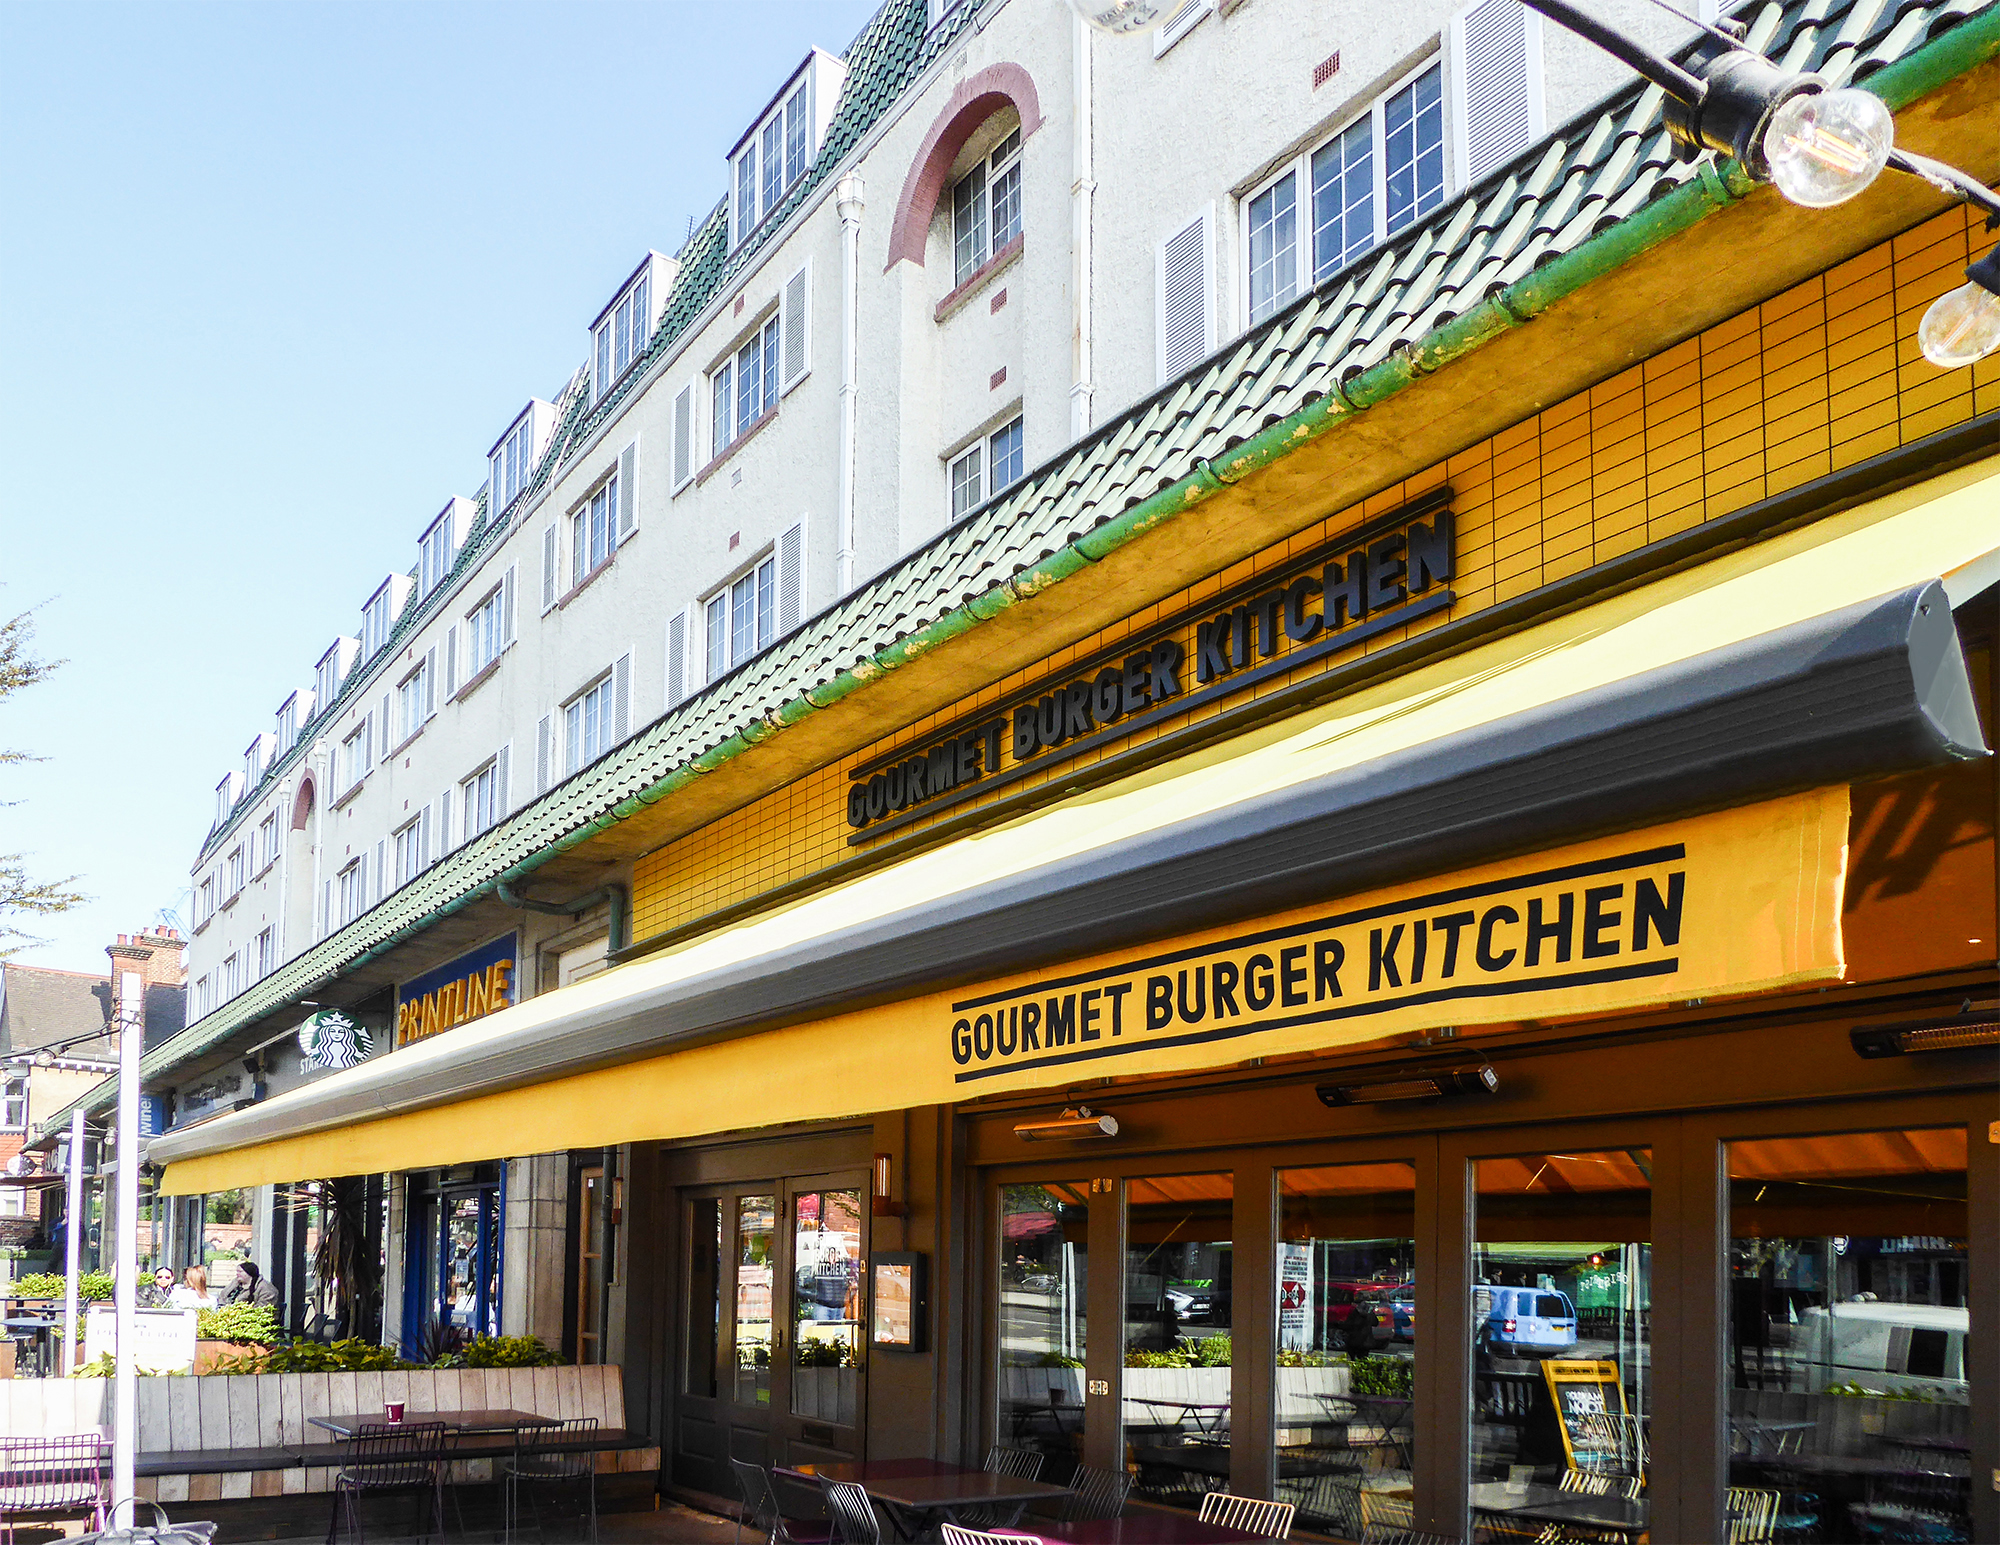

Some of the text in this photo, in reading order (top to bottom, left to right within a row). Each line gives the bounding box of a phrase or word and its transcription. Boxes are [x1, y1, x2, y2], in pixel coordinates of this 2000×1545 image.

[847, 509, 1455, 828] GOURMET BURGER KITCHEN
[397, 958, 513, 1046] PRINTLINE
[951, 871, 1686, 1065] GOURMET BURGER KITCHEN
[300, 1056, 321, 1075] STAR
[814, 1261, 846, 1276] KITCHEN
